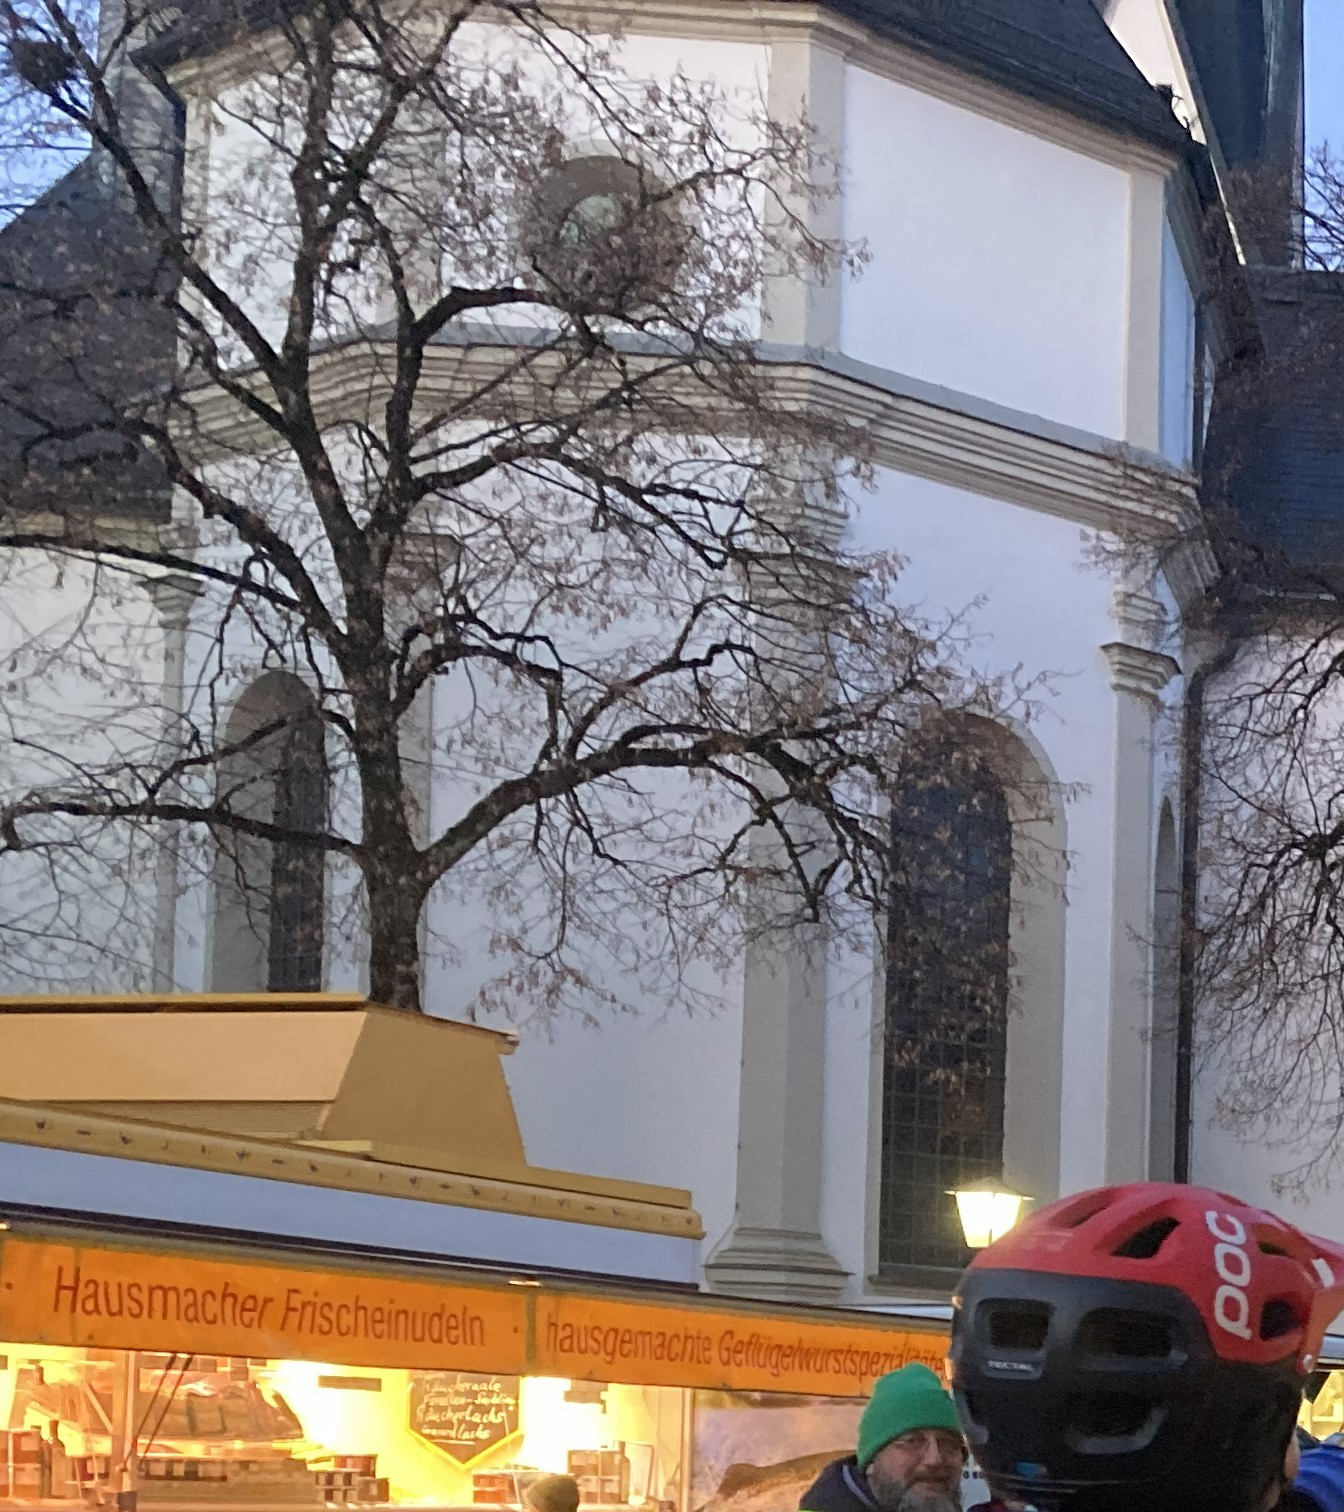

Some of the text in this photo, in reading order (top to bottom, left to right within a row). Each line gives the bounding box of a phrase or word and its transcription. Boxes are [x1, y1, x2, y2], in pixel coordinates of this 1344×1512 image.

[52, 1265, 486, 1347] Hausmacher Frischeinudeln
[1205, 1209, 1251, 1341] POC
[546, 1311, 712, 1365] Hausgemachte
